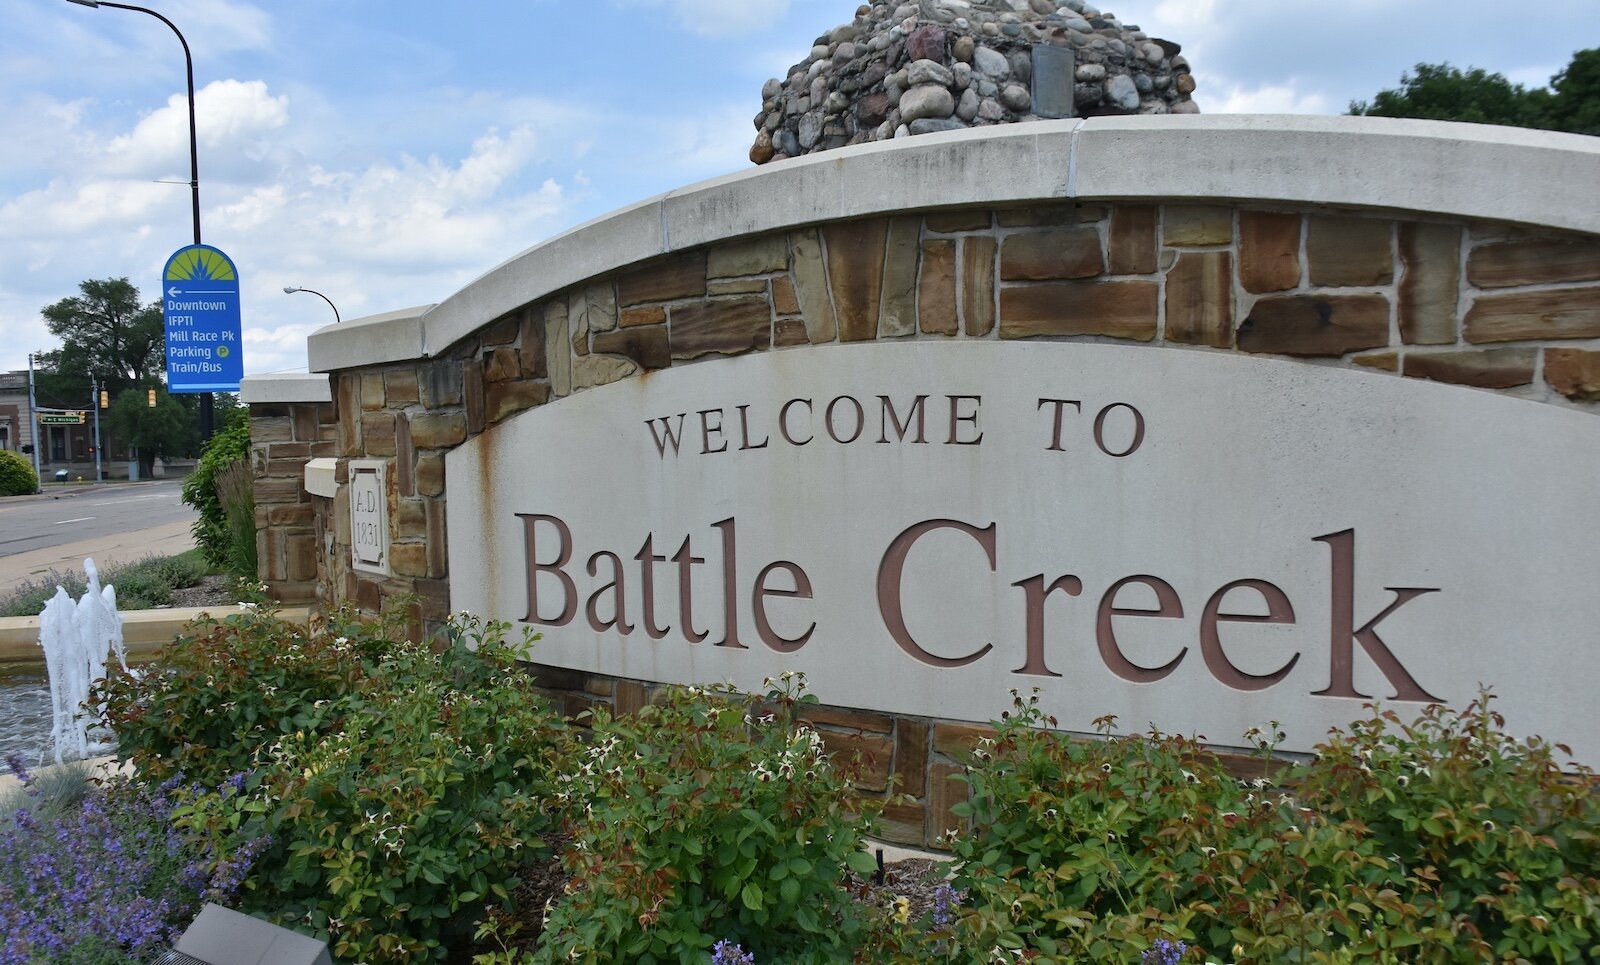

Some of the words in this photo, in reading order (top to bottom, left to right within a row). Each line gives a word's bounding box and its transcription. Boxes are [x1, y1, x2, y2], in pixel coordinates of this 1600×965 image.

[168, 300, 226, 311] Downtown
[168, 316, 193, 326] IFPTI
[169, 330, 189, 342] Mill
[192, 331, 218, 342] Race
[221, 330, 235, 342] Pk
[170, 346, 211, 359] Parking
[170, 362, 222, 373] Train/Bus
[644, 394, 985, 461] WELCOME
[1037, 397, 1146, 458] TO
[356, 490, 377, 513] A.D.
[356, 522, 378, 547] 1831
[513, 511, 818, 654] Battle
[876, 517, 1446, 705] Creek
